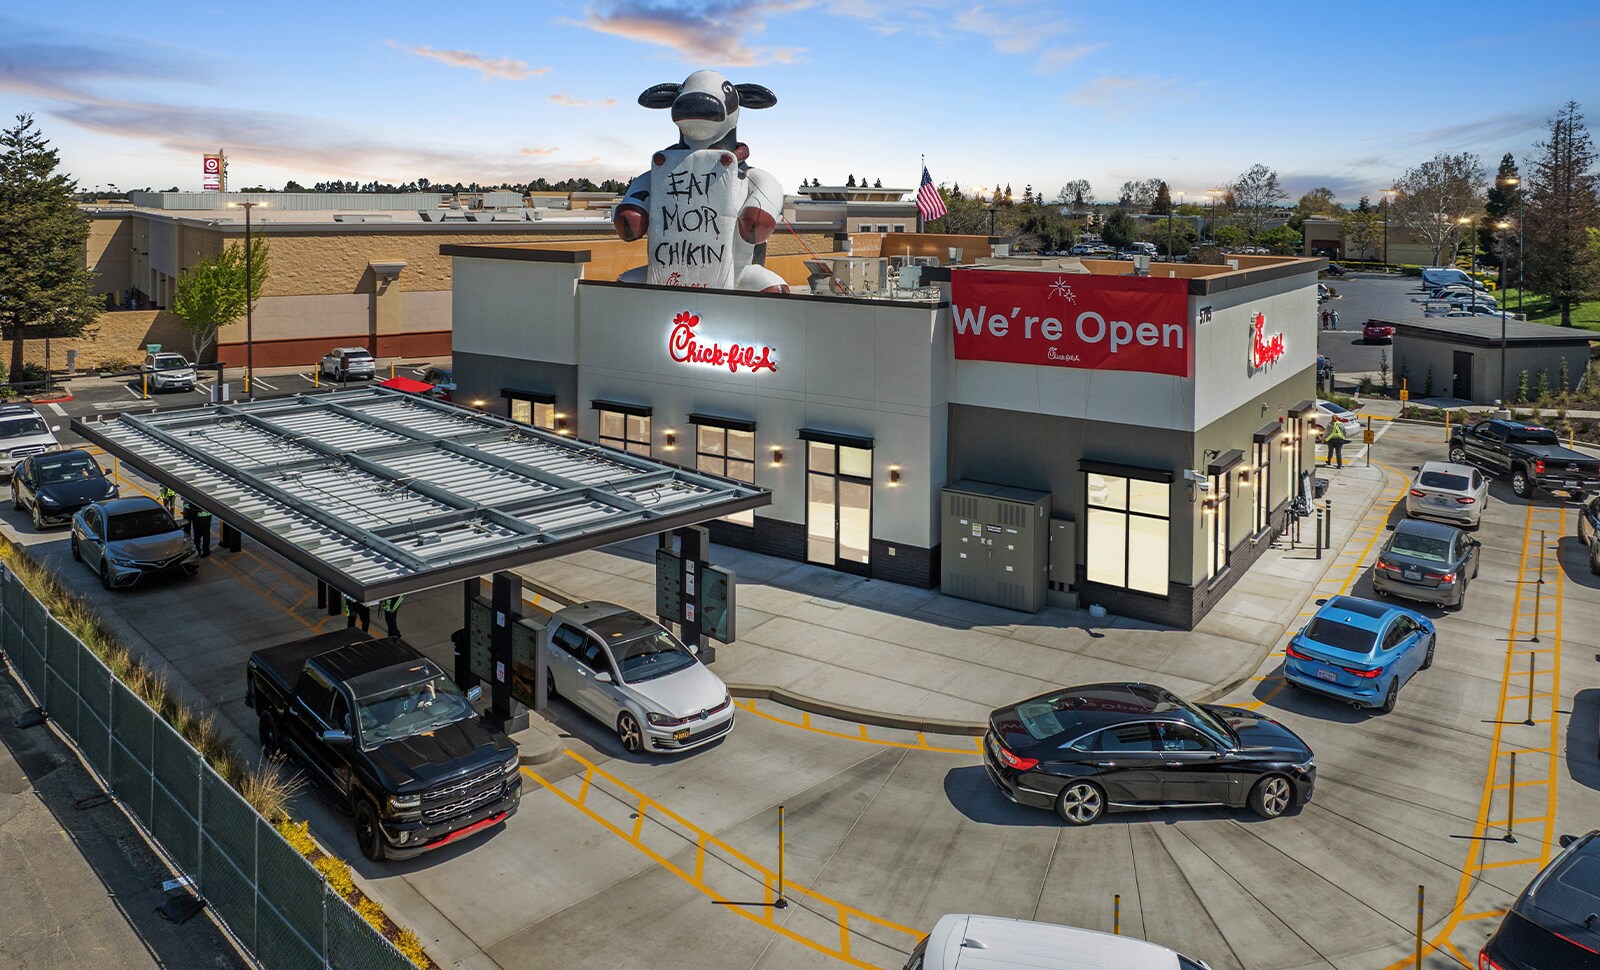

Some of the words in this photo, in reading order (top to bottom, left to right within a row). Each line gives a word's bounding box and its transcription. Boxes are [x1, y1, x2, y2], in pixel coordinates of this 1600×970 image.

[667, 170, 717, 202] EAT
[661, 204, 721, 239] MOR
[654, 240, 726, 267] CHIKIN
[669, 311, 777, 373] Chick-fil-A
[952, 304, 1063, 341] We're
[1075, 311, 1184, 353] Open
